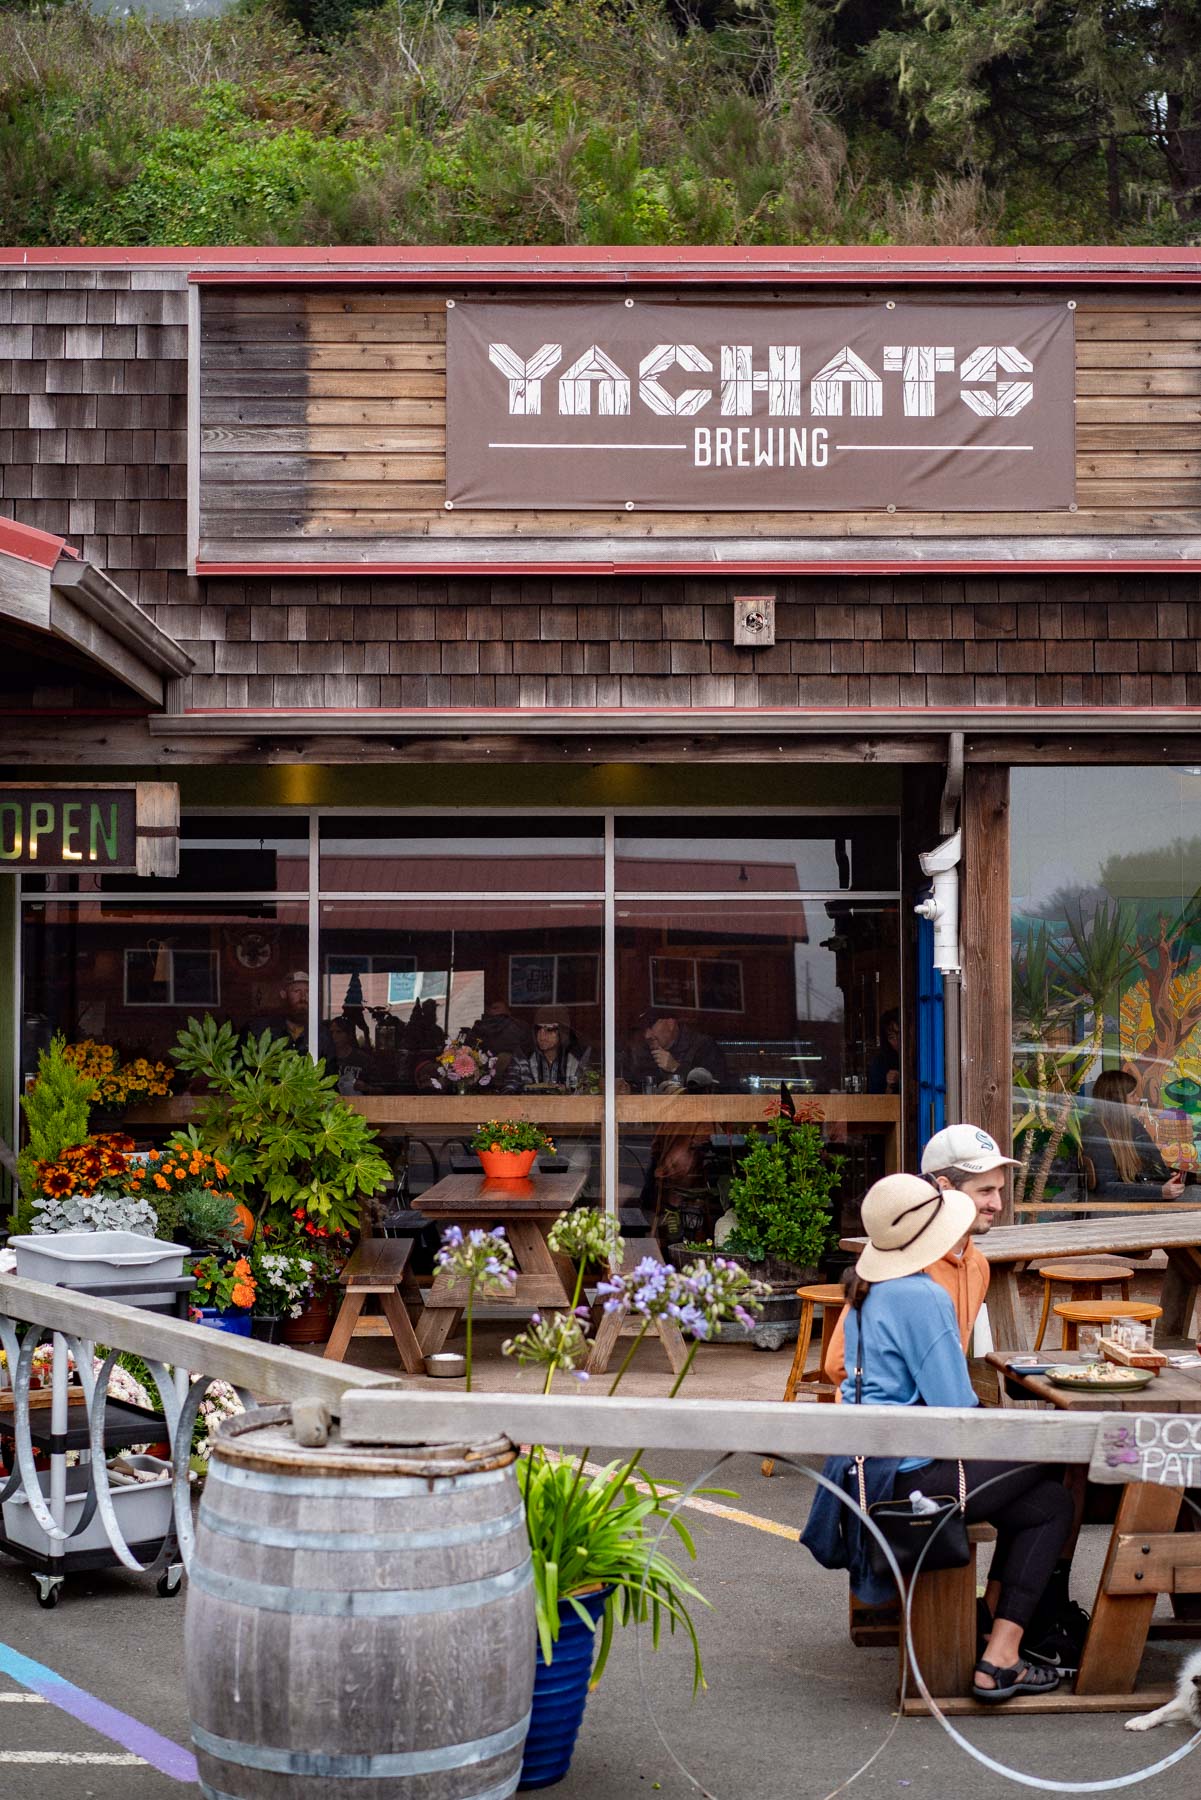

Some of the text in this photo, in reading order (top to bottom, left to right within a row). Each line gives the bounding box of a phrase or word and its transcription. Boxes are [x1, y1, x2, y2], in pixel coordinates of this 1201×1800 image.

[488, 344, 1034, 417] YACHATS
[694, 427, 829, 467] BREWING
[0, 803, 118, 860] OPEN
